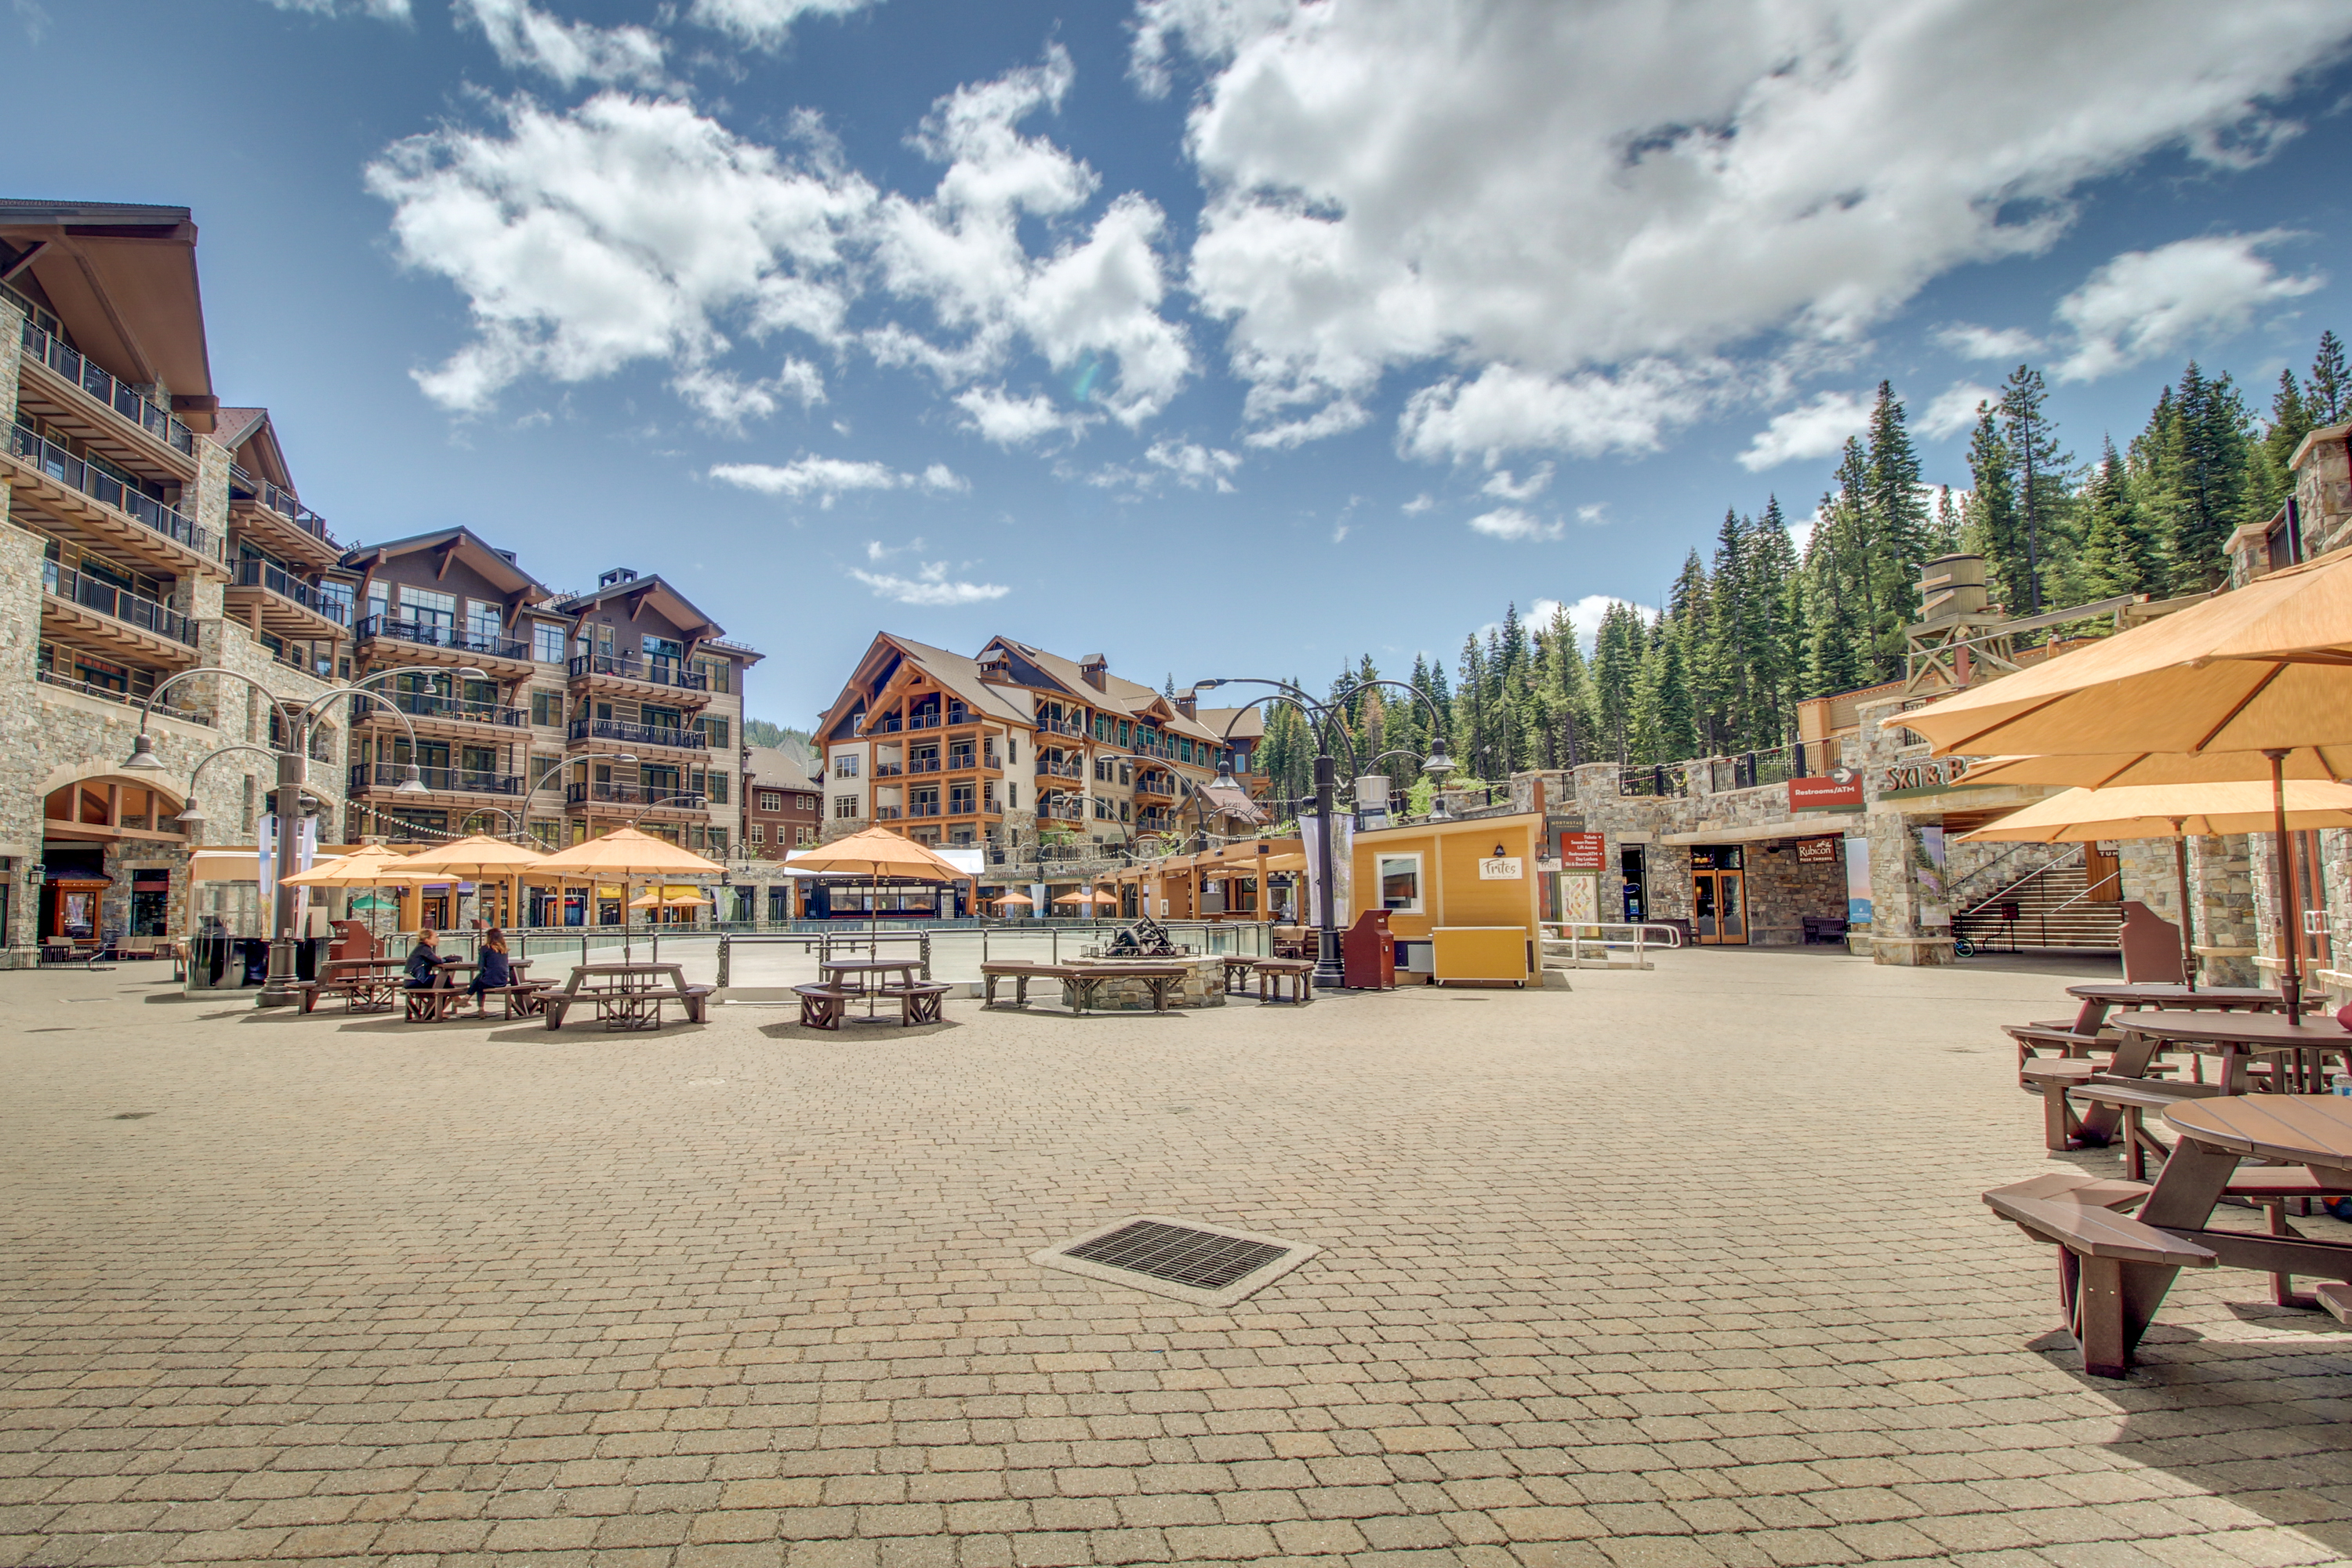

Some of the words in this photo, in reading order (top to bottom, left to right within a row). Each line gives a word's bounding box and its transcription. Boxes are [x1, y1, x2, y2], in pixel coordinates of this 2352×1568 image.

[1885, 766, 1919, 791] SKI
[1926, 764, 1940, 785] &
[1795, 786, 1855, 796] Restrooms/ATM
[1798, 844, 1831, 857] Rubicon
[1022, 867, 1050, 878] LESSS
[1481, 858, 1516, 875] Frites
